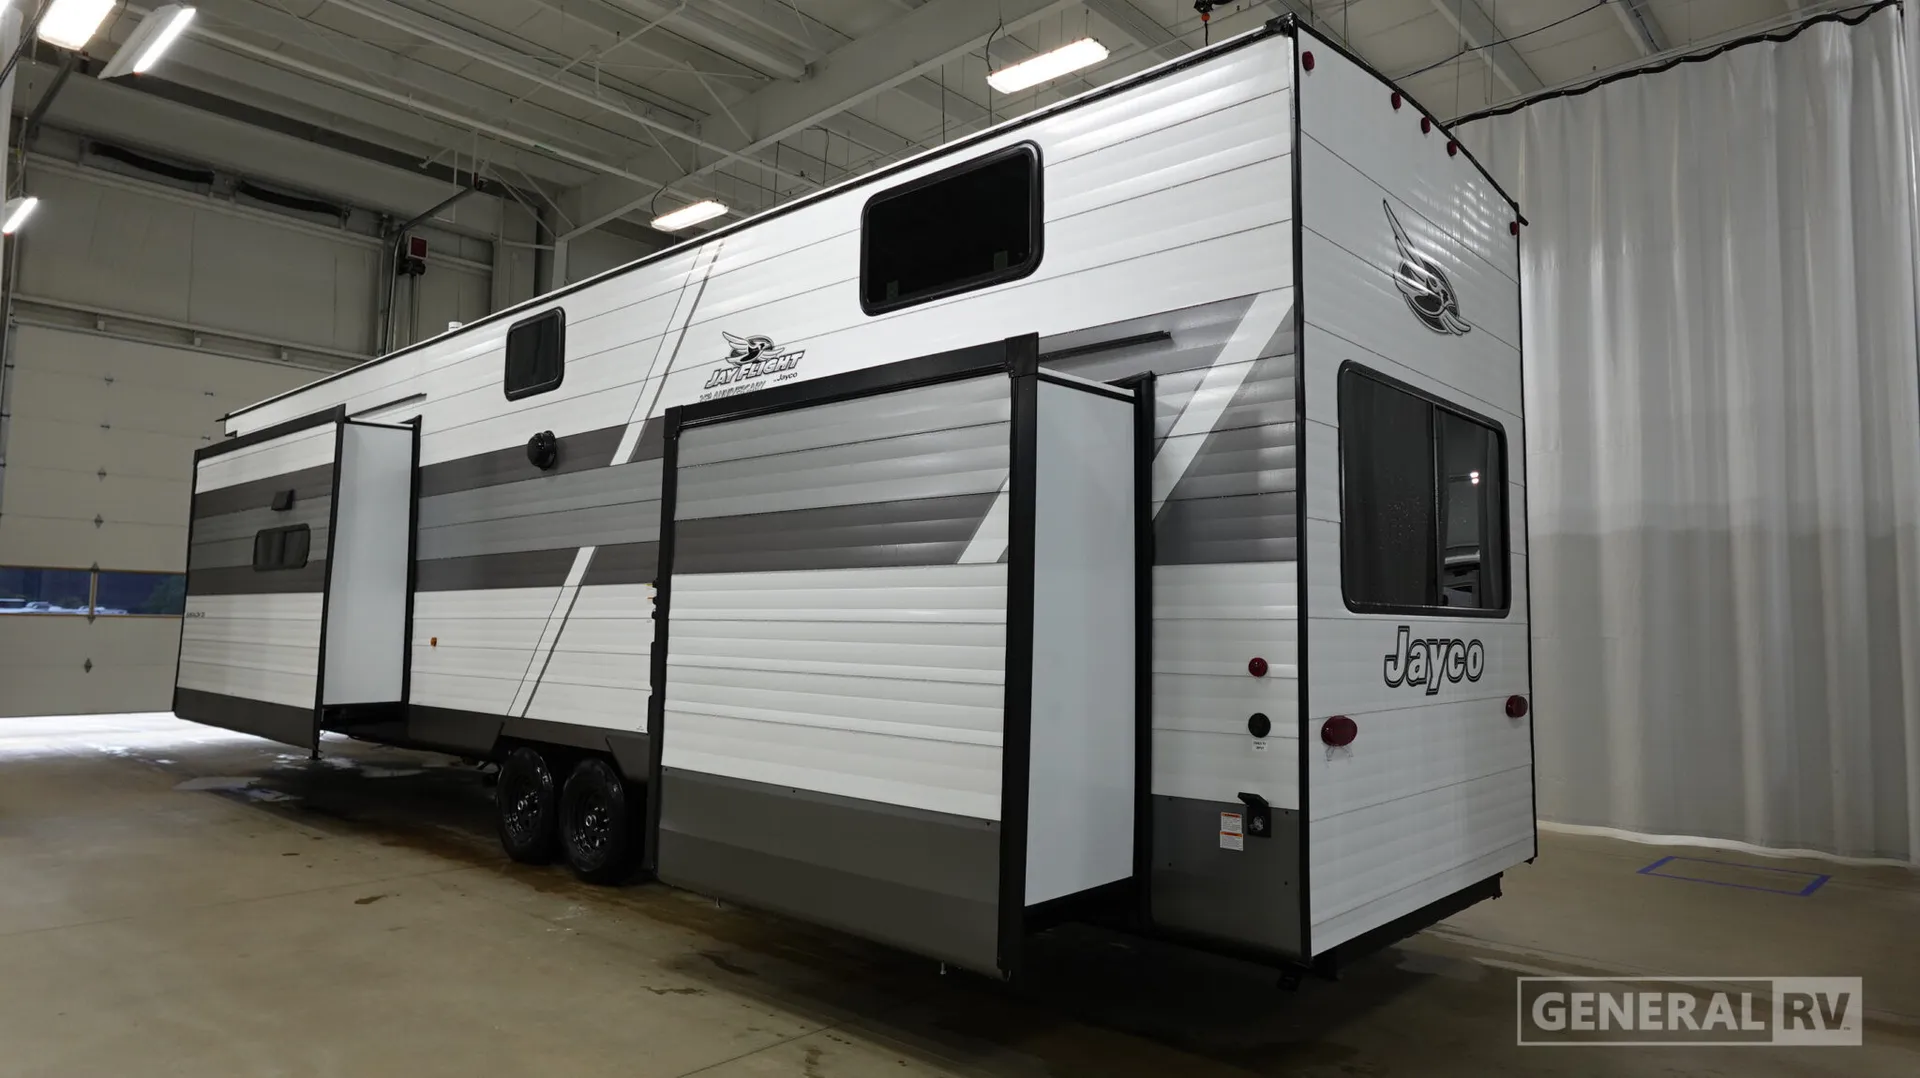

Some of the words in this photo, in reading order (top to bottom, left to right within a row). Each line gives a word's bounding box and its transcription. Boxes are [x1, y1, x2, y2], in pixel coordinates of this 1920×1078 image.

[704, 367, 740, 389] JAY
[737, 350, 805, 381] FLIGHT
[777, 372, 798, 382] Jayco
[1384, 625, 1484, 696] Jayco
